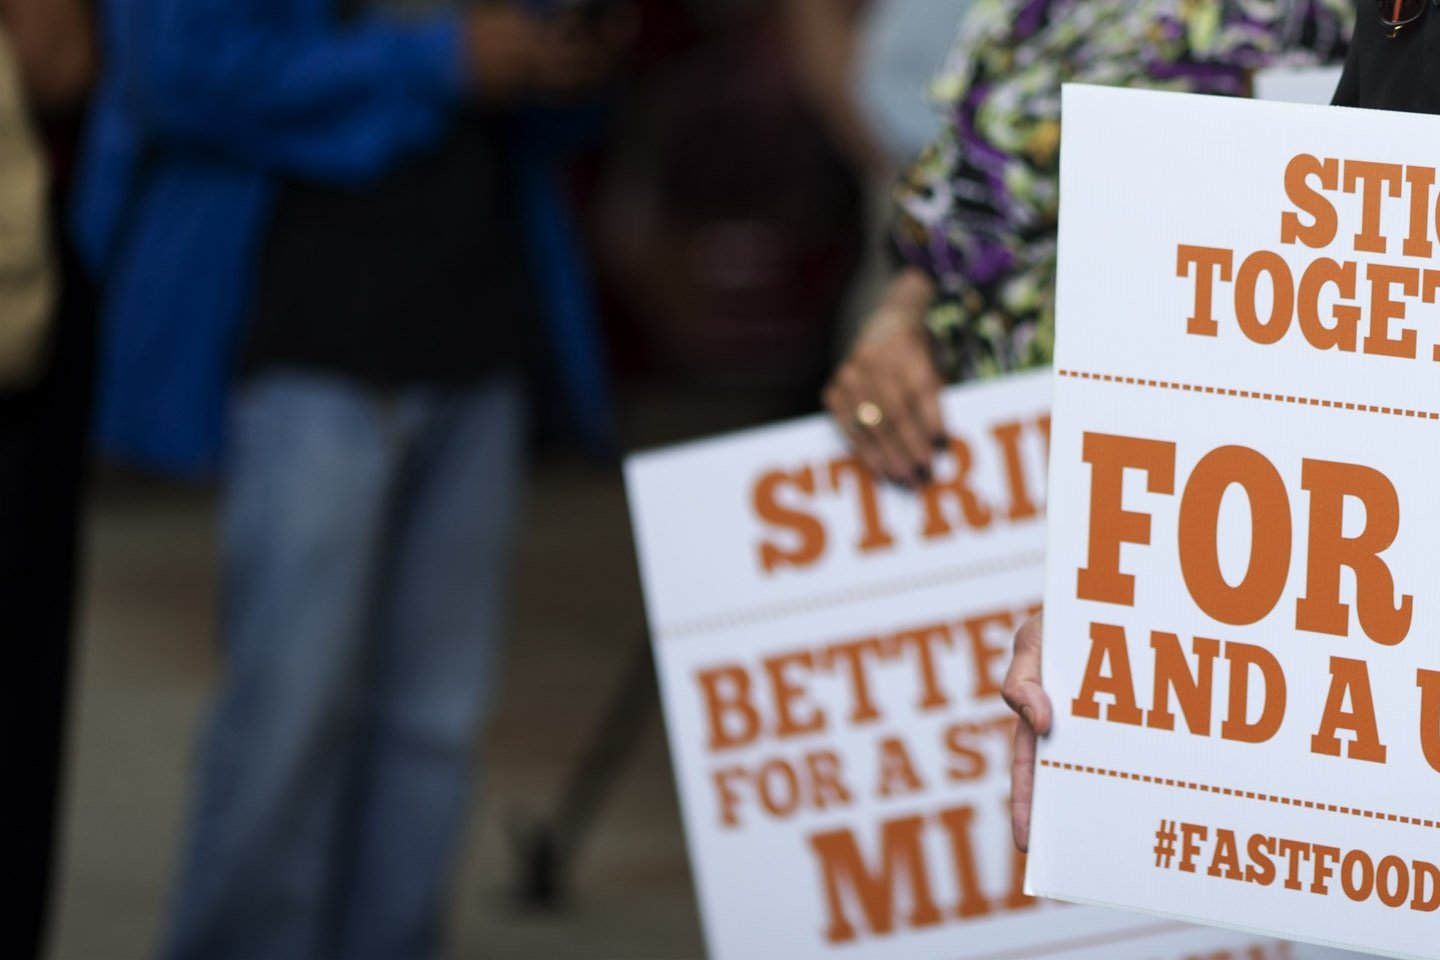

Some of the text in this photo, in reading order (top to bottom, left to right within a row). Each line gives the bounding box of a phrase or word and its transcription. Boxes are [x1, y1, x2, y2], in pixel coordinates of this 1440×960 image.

[750, 414, 1051, 575] STRI
[1077, 432, 1413, 646] FOR
[696, 603, 1043, 754] BETTE
[1071, 623, 1287, 744] AND
[1311, 655, 1387, 764] A
[712, 748, 853, 829] FOR
[876, 736, 924, 798] A
